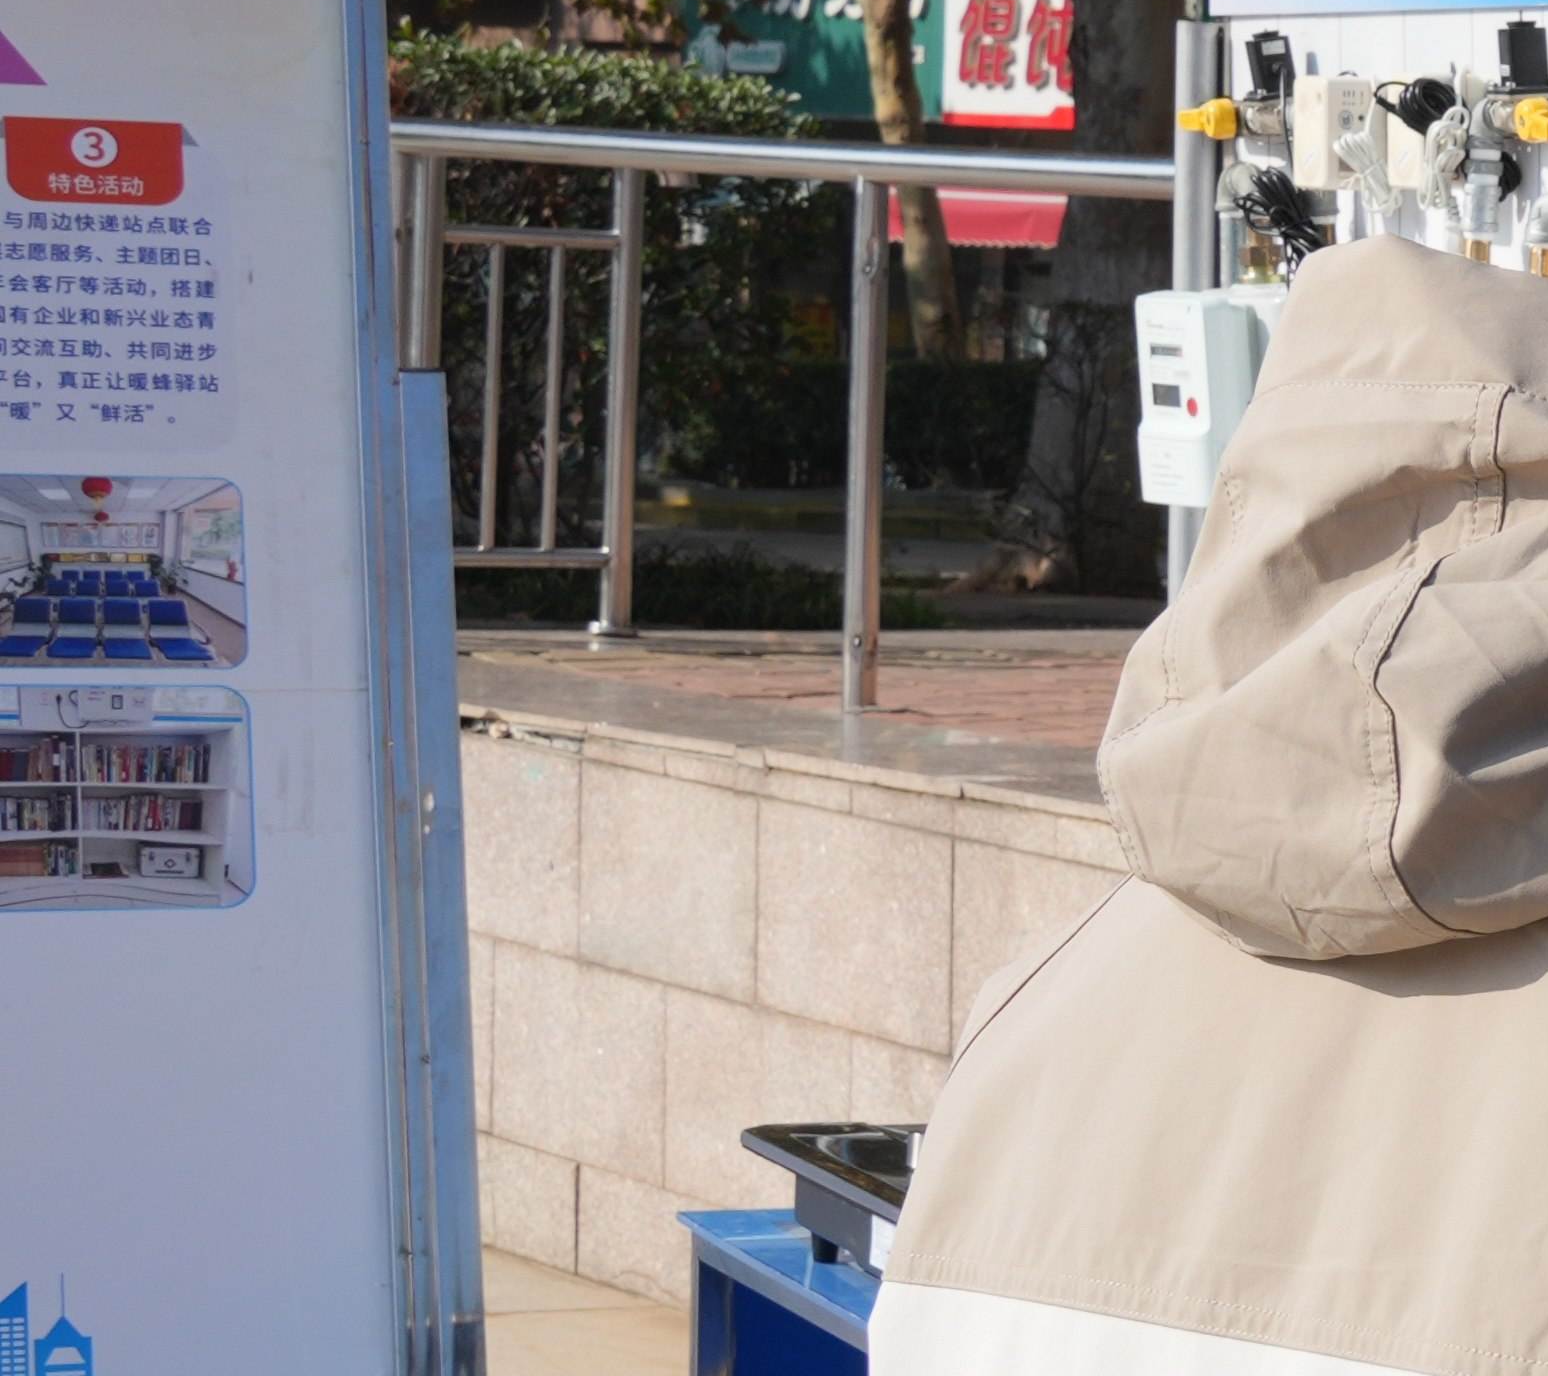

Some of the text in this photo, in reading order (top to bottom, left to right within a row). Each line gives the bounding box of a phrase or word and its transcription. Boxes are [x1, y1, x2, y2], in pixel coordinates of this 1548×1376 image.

[83, 132, 105, 162] 3
[48, 173, 145, 197] 特色活动
[4, 211, 213, 236] 与周边快递站点联合
[0, 242, 212, 267] 志愿服务、主题团日、
[0, 274, 216, 299] 会客厅等活动，搭建
[0, 305, 215, 330] 有企业和新兴业态青
